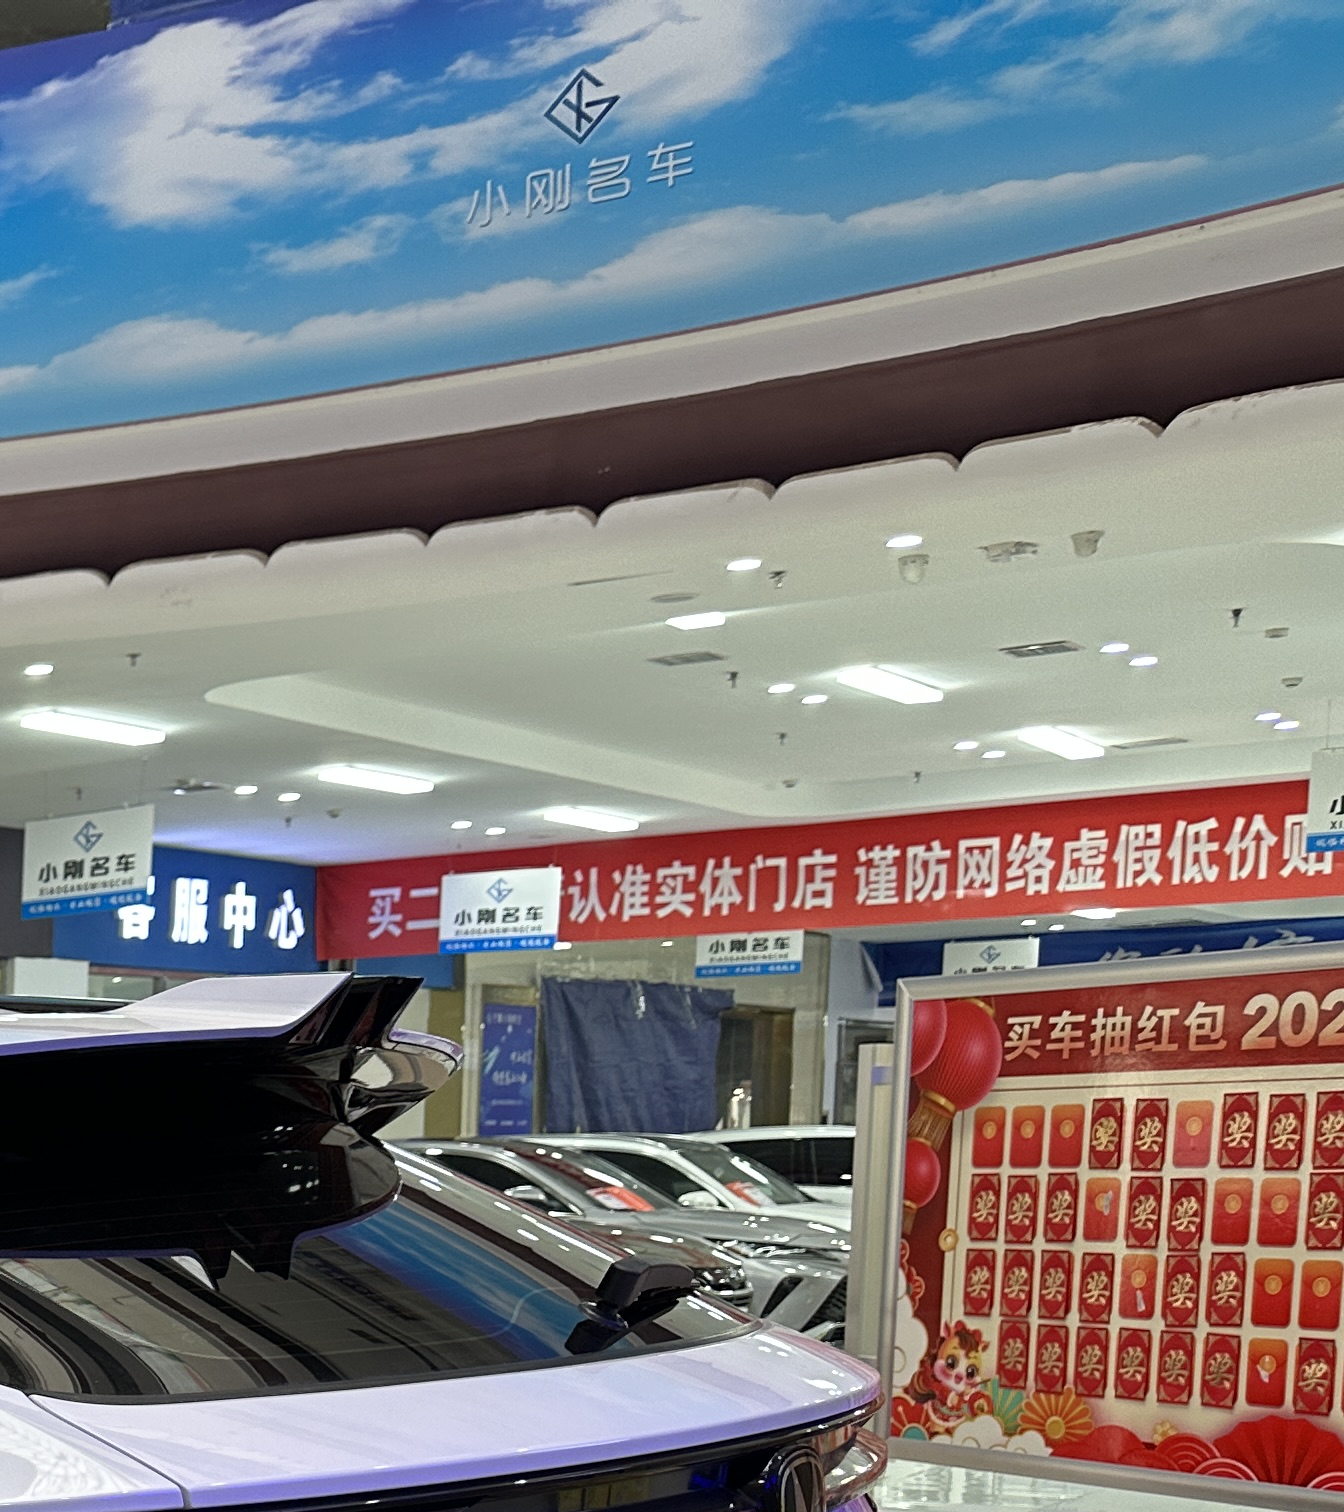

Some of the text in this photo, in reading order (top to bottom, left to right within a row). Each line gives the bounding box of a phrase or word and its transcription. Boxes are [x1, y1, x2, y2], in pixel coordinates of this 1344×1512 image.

[467, 142, 694, 228] 小刚名车
[38, 853, 136, 883] 小刚名车
[453, 906, 543, 926] 小刚名车
[709, 936, 791, 954] 小刚名车
[1004, 1001, 1227, 1061] 买车抽红包
